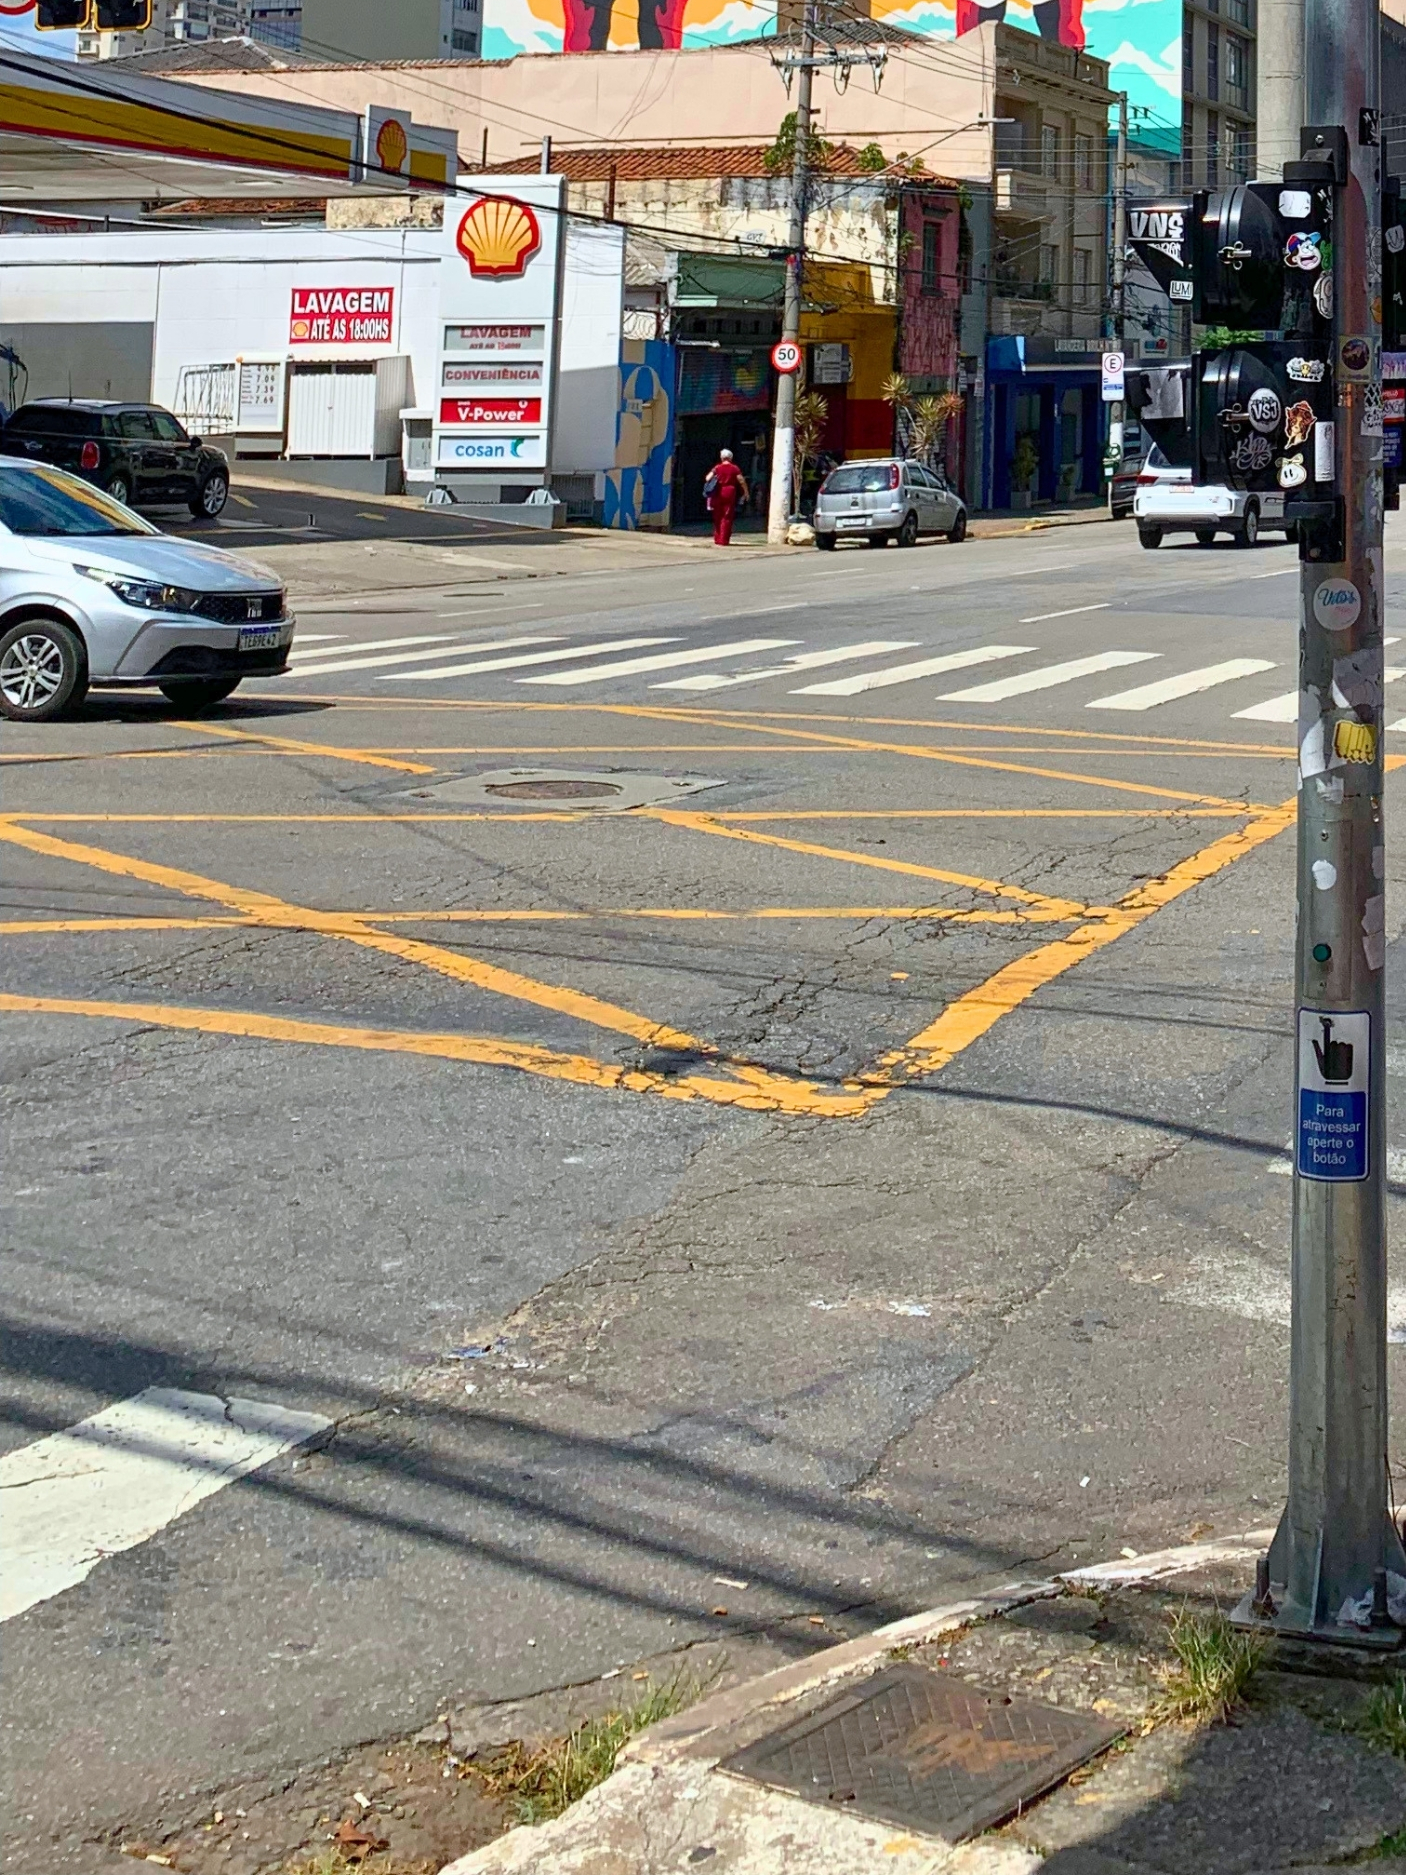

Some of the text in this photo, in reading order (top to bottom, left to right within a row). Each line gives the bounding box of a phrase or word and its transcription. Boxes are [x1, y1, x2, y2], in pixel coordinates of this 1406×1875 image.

[293, 291, 390, 314] LAVAGEM
[310, 314, 390, 340] ATÉ AS 18:00HS
[460, 325, 532, 339] LAVAGEM
[777, 347, 796, 361] 50
[1109, 358, 1117, 369] E
[445, 368, 540, 381] CONVENIÊNCIA
[457, 407, 525, 421] V-Power
[455, 444, 505, 458] cosan
[1316, 1103, 1344, 1118] Para
[1302, 1119, 1361, 1133] atravessar
[1307, 1137, 1354, 1150] aperte o
[1313, 1150, 1346, 1164] botão
